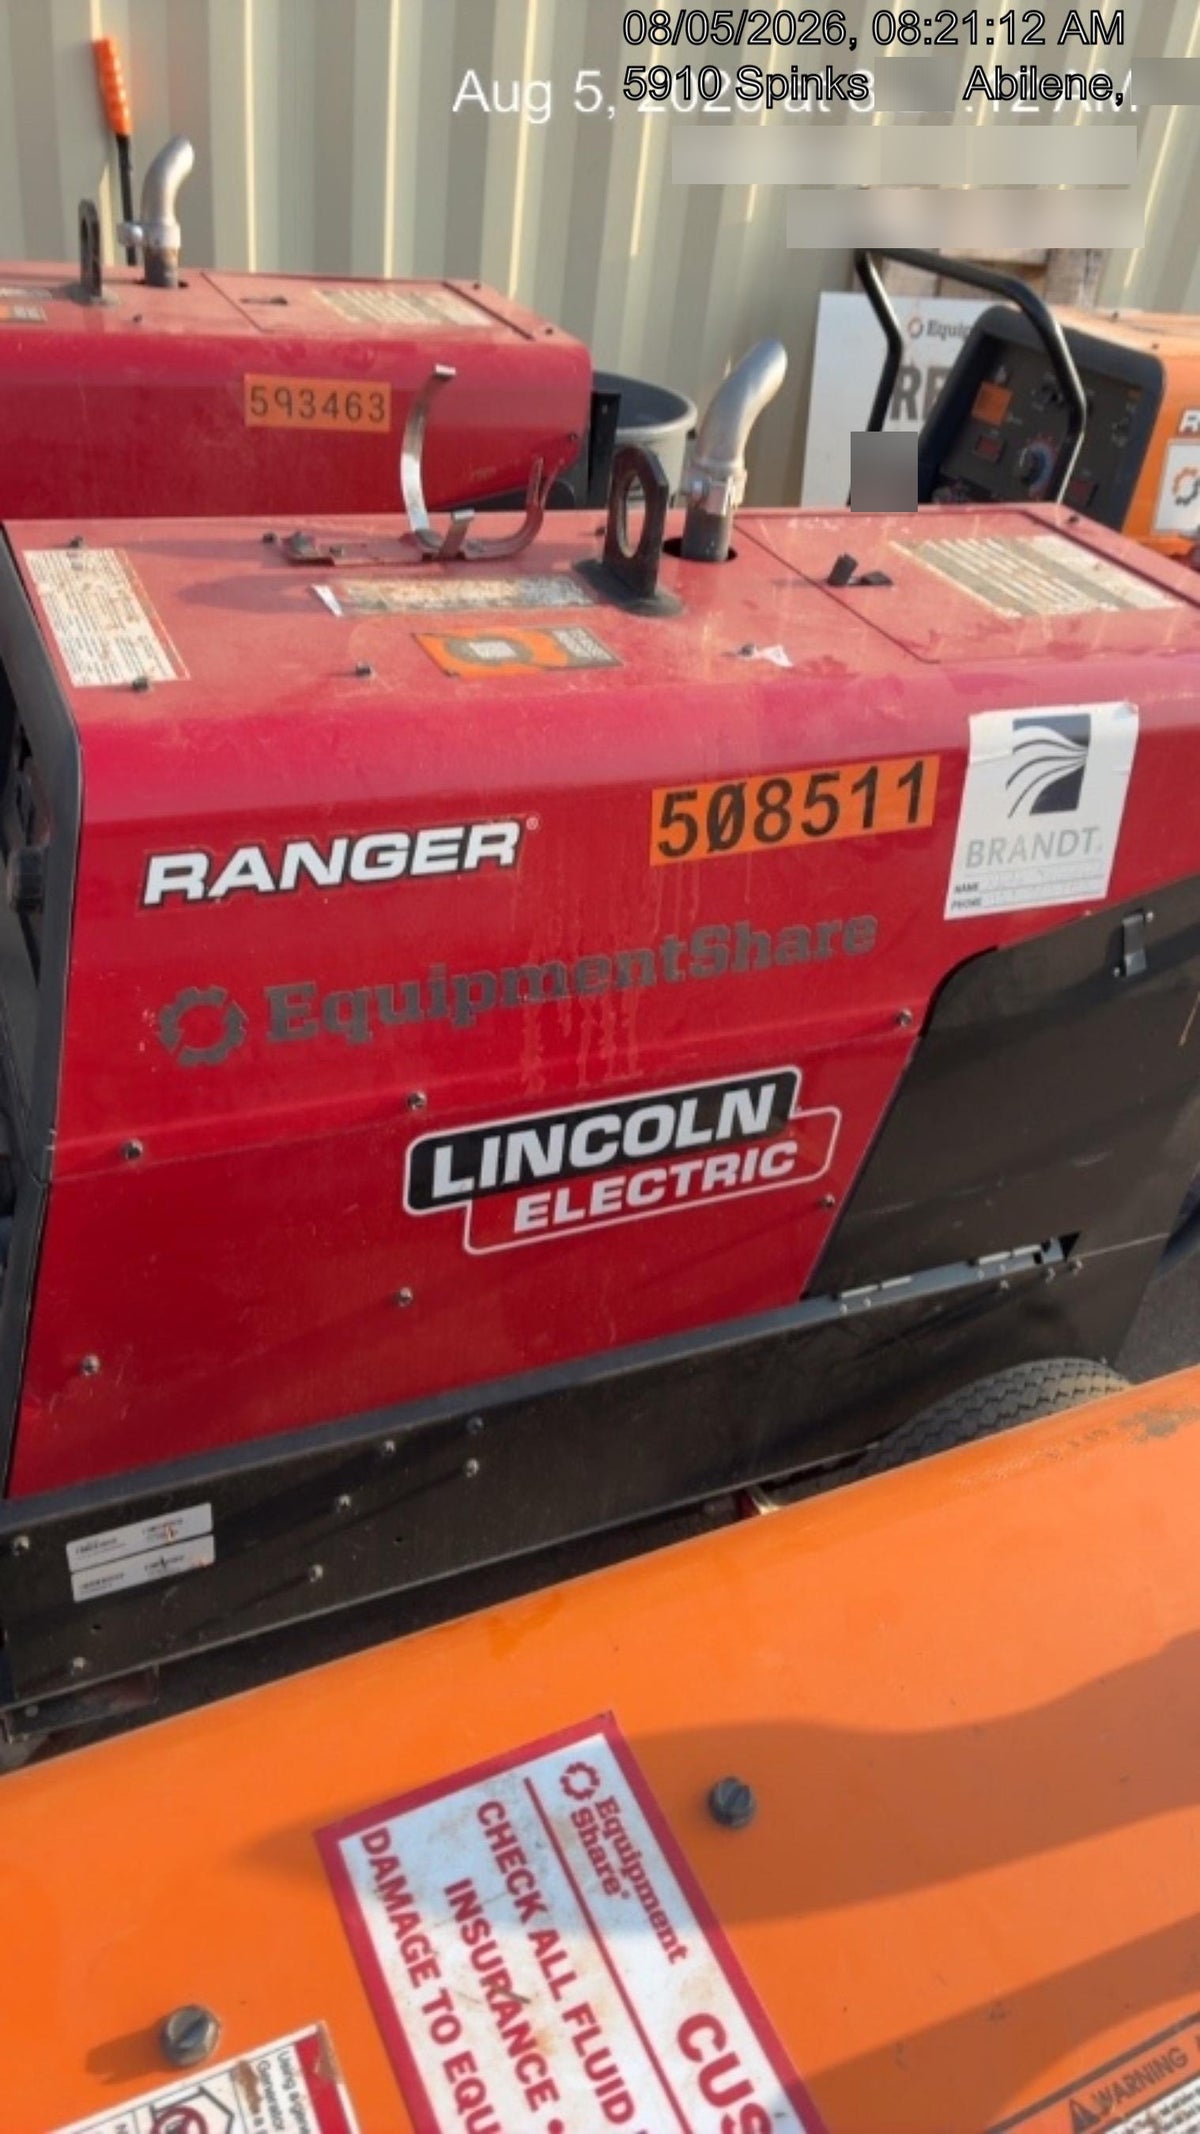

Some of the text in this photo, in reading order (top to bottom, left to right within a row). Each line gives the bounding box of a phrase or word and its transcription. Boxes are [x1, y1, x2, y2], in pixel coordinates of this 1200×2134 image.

[250, 385, 385, 423] 593463
[657, 760, 924, 858] 508511
[265, 915, 878, 1046] EquipmentShare
[431, 1083, 777, 1199] LINCOLN
[514, 1141, 798, 1234] ELECTRIC
[360, 1827, 441, 1989] DAMAGE
[421, 1988, 462, 2046] TO
[595, 1795, 689, 1964] Equipment
[444, 1878, 560, 2113] INSURANCE
[476, 1800, 635, 2125] CHECK ALL FLUID
[1090, 2047, 1188, 2116] WARNING
